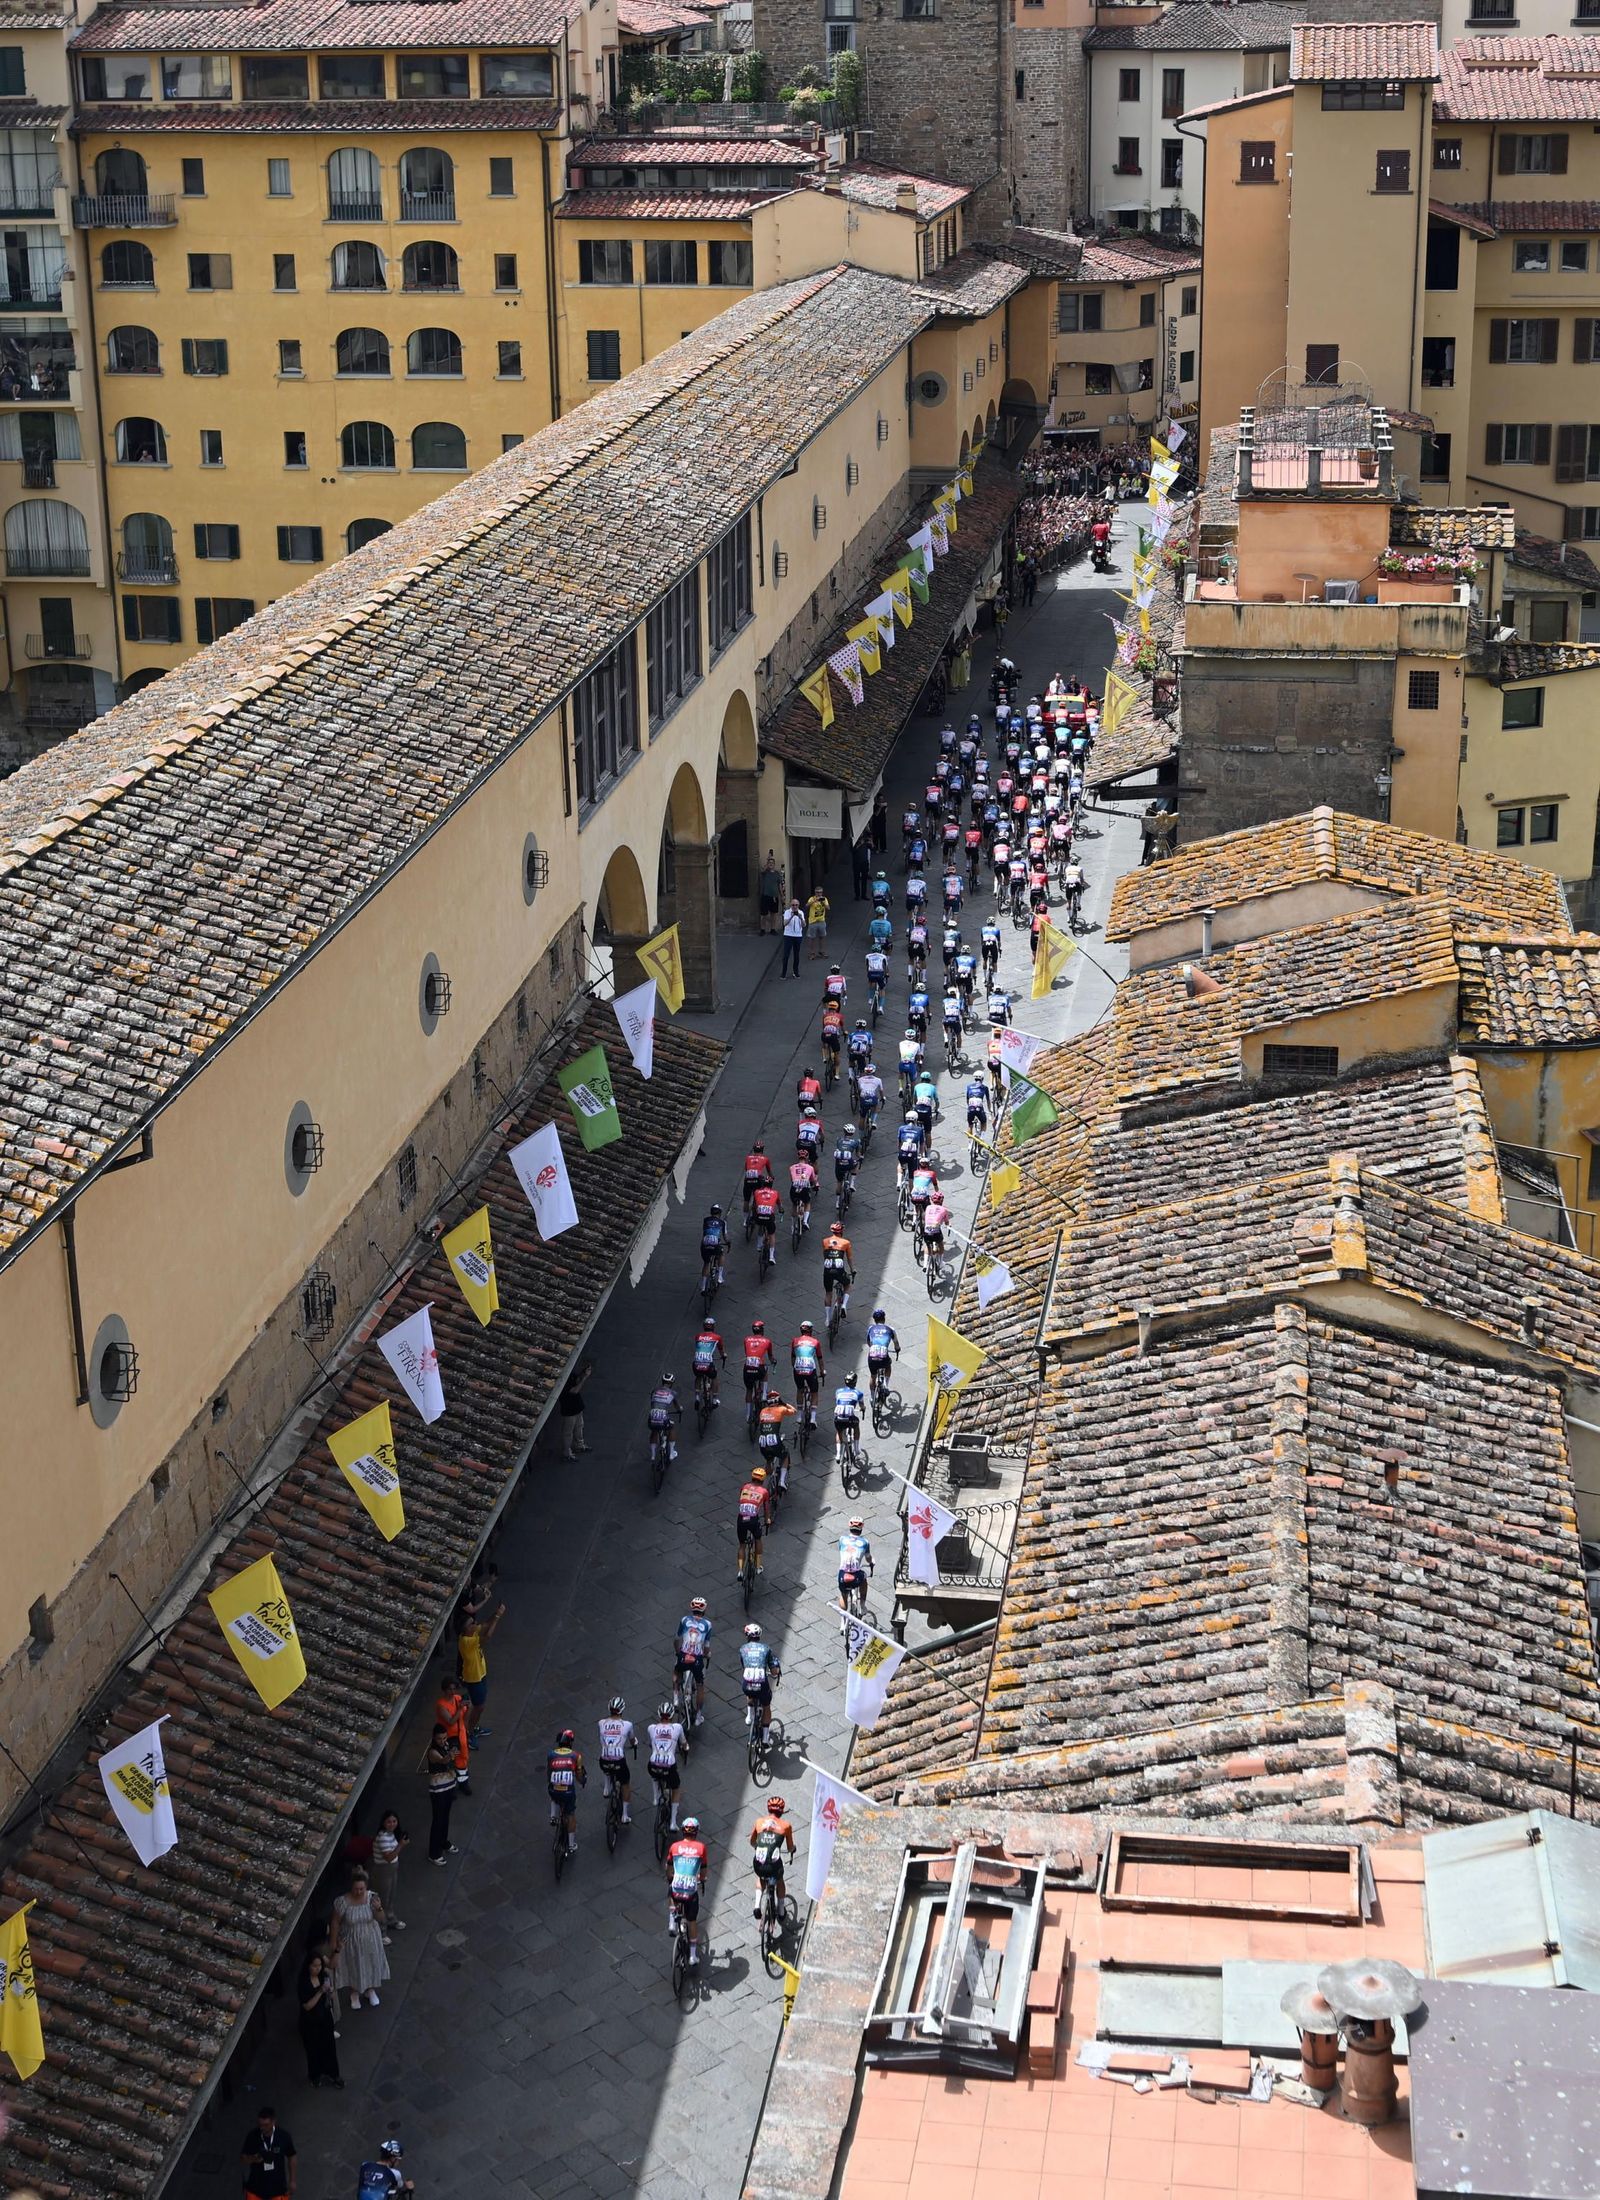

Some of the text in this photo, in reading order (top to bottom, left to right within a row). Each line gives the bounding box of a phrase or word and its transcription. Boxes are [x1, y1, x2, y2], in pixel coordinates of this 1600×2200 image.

[800, 809, 829, 818] ROLEX
[397, 1349, 425, 1393] FIRENZ
[366, 1456, 383, 1471] GRAND
[362, 1475, 374, 1485] 2024
[367, 1464, 389, 1484] FLORENCE
[246, 1615, 265, 1632] GRAND
[242, 1635, 255, 1647] 2024
[247, 1623, 272, 1646] FLORENCE
[129, 1766, 148, 1785] GRAND
[122, 1788, 137, 1802] 2024
